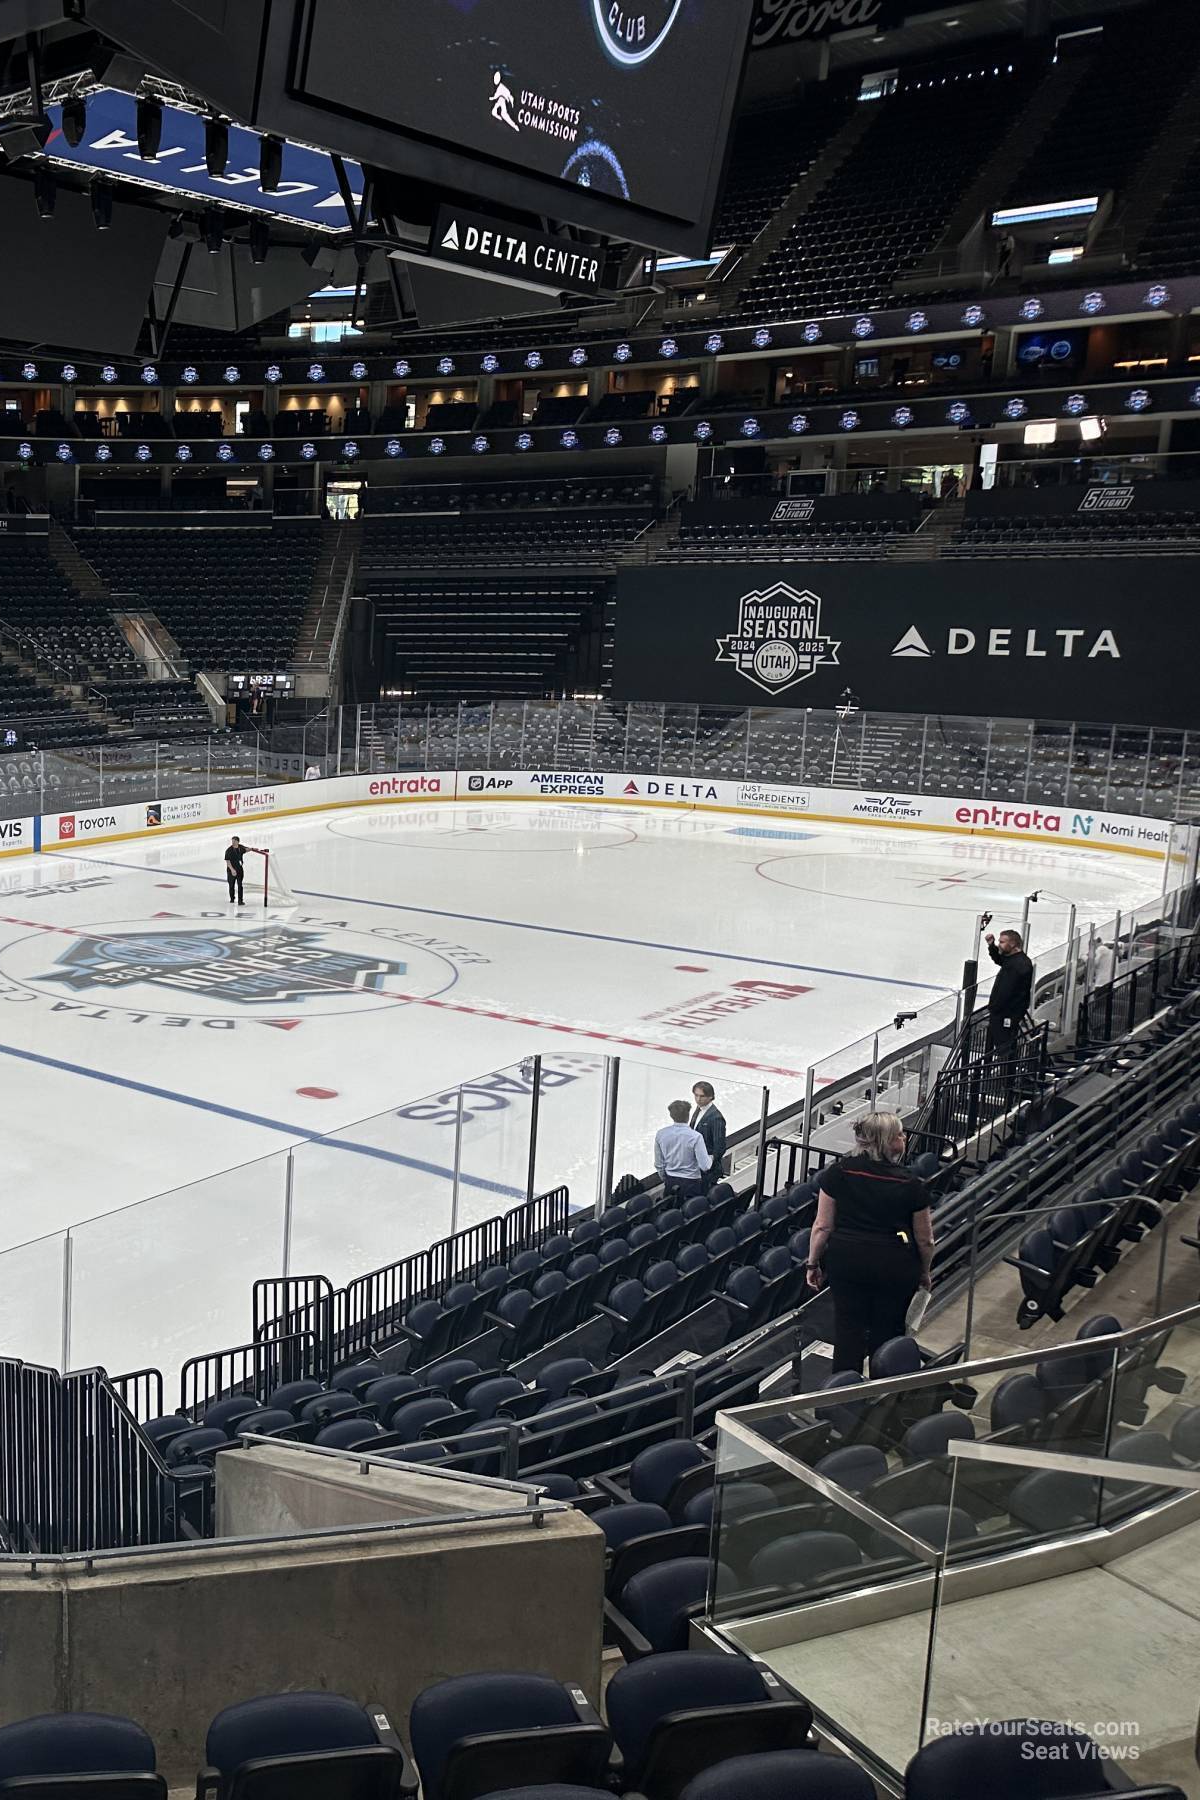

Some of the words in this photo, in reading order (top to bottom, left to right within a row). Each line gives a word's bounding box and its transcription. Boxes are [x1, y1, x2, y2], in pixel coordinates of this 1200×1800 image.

[609, 1, 646, 42] CLUB
[520, 90, 546, 111] UTAH
[546, 100, 580, 125] SPORTS
[517, 108, 577, 142] COMMISSION
[464, 226, 528, 266] DELTA
[533, 245, 599, 283] CENTER
[1083, 491, 1102, 508] 5
[775, 503, 789, 519] 5
[744, 605, 815, 620] INAUGURAL
[742, 619, 815, 639] SEASON
[730, 640, 756, 651] 2024
[798, 641, 825, 652] 2025
[947, 627, 1121, 659] DELTA
[760, 655, 791, 670] UTAH
[369, 776, 441, 795] entrata
[530, 773, 604, 785] AMERICAN
[540, 784, 604, 796] EXPRESS
[647, 781, 718, 800] DELTA
[740, 785, 762, 793] JUST
[243, 793, 275, 807] HEALTH
[741, 793, 807, 806] INGREDIENTS
[852, 804, 894, 815] AMERICA
[895, 808, 923, 817] FIRST
[955, 806, 1061, 832] entrata
[78, 816, 117, 831] TOYOTA
[1100, 822, 1135, 838] Nomi
[1137, 827, 1178, 844] Healt
[200, 911, 349, 929] DELTA
[370, 927, 492, 968] CENTER
[149, 946, 333, 990] SEASON
[50, 1001, 237, 1031] DELTA
[661, 994, 768, 1029] HEALTH
